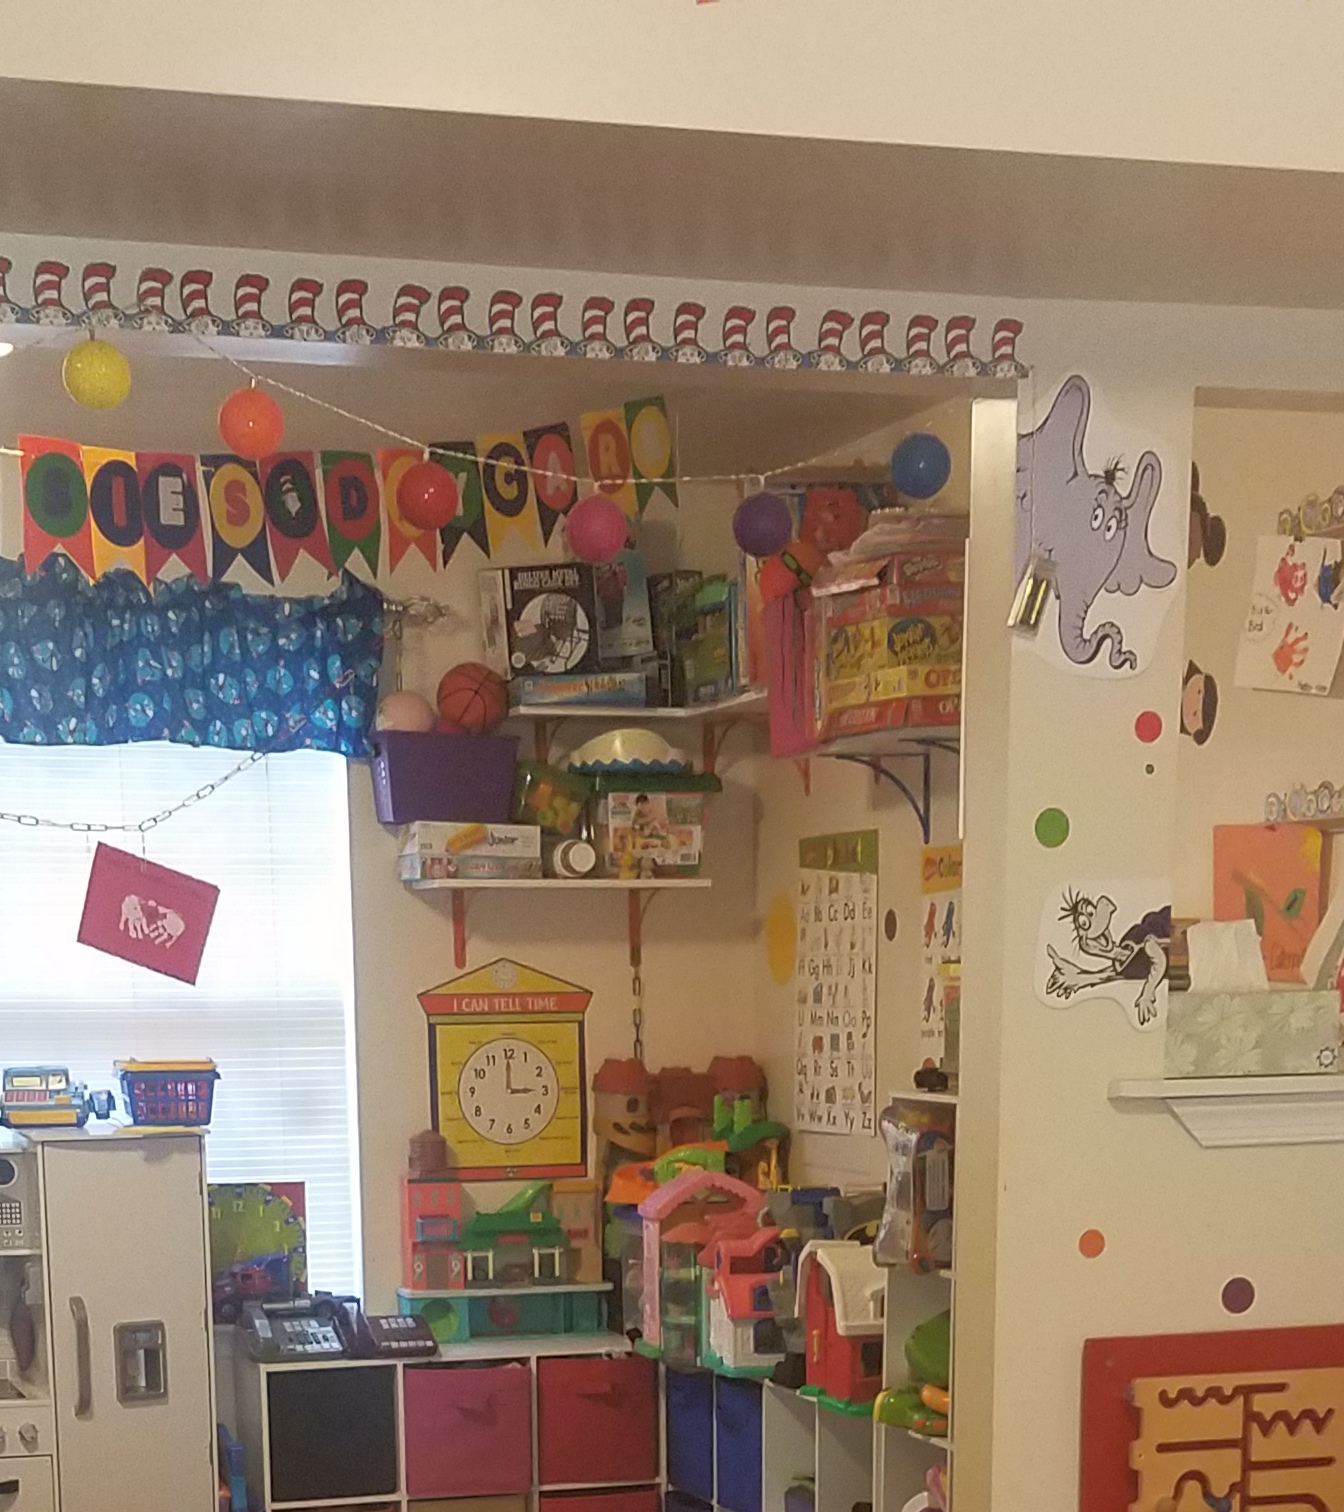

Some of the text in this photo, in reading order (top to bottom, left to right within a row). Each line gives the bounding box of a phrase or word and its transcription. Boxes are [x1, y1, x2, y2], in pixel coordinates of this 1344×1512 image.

[462, 997, 489, 1013] CAN
[493, 997, 522, 1012] TELL
[525, 996, 558, 1011] TIME
[485, 1054, 497, 1067] 11
[502, 1047, 516, 1061] 12
[523, 1051, 529, 1064] 1
[473, 1067, 487, 1081] 10
[535, 1065, 544, 1079] 2
[468, 1086, 477, 1099] 9
[541, 1084, 550, 1097] 3
[474, 1104, 483, 1118] 8
[533, 1103, 542, 1116] 4
[488, 1118, 497, 1131] 7
[522, 1118, 531, 1131] 5
[861, 1110, 873, 1130] Zz
[505, 1122, 514, 1135] 6
